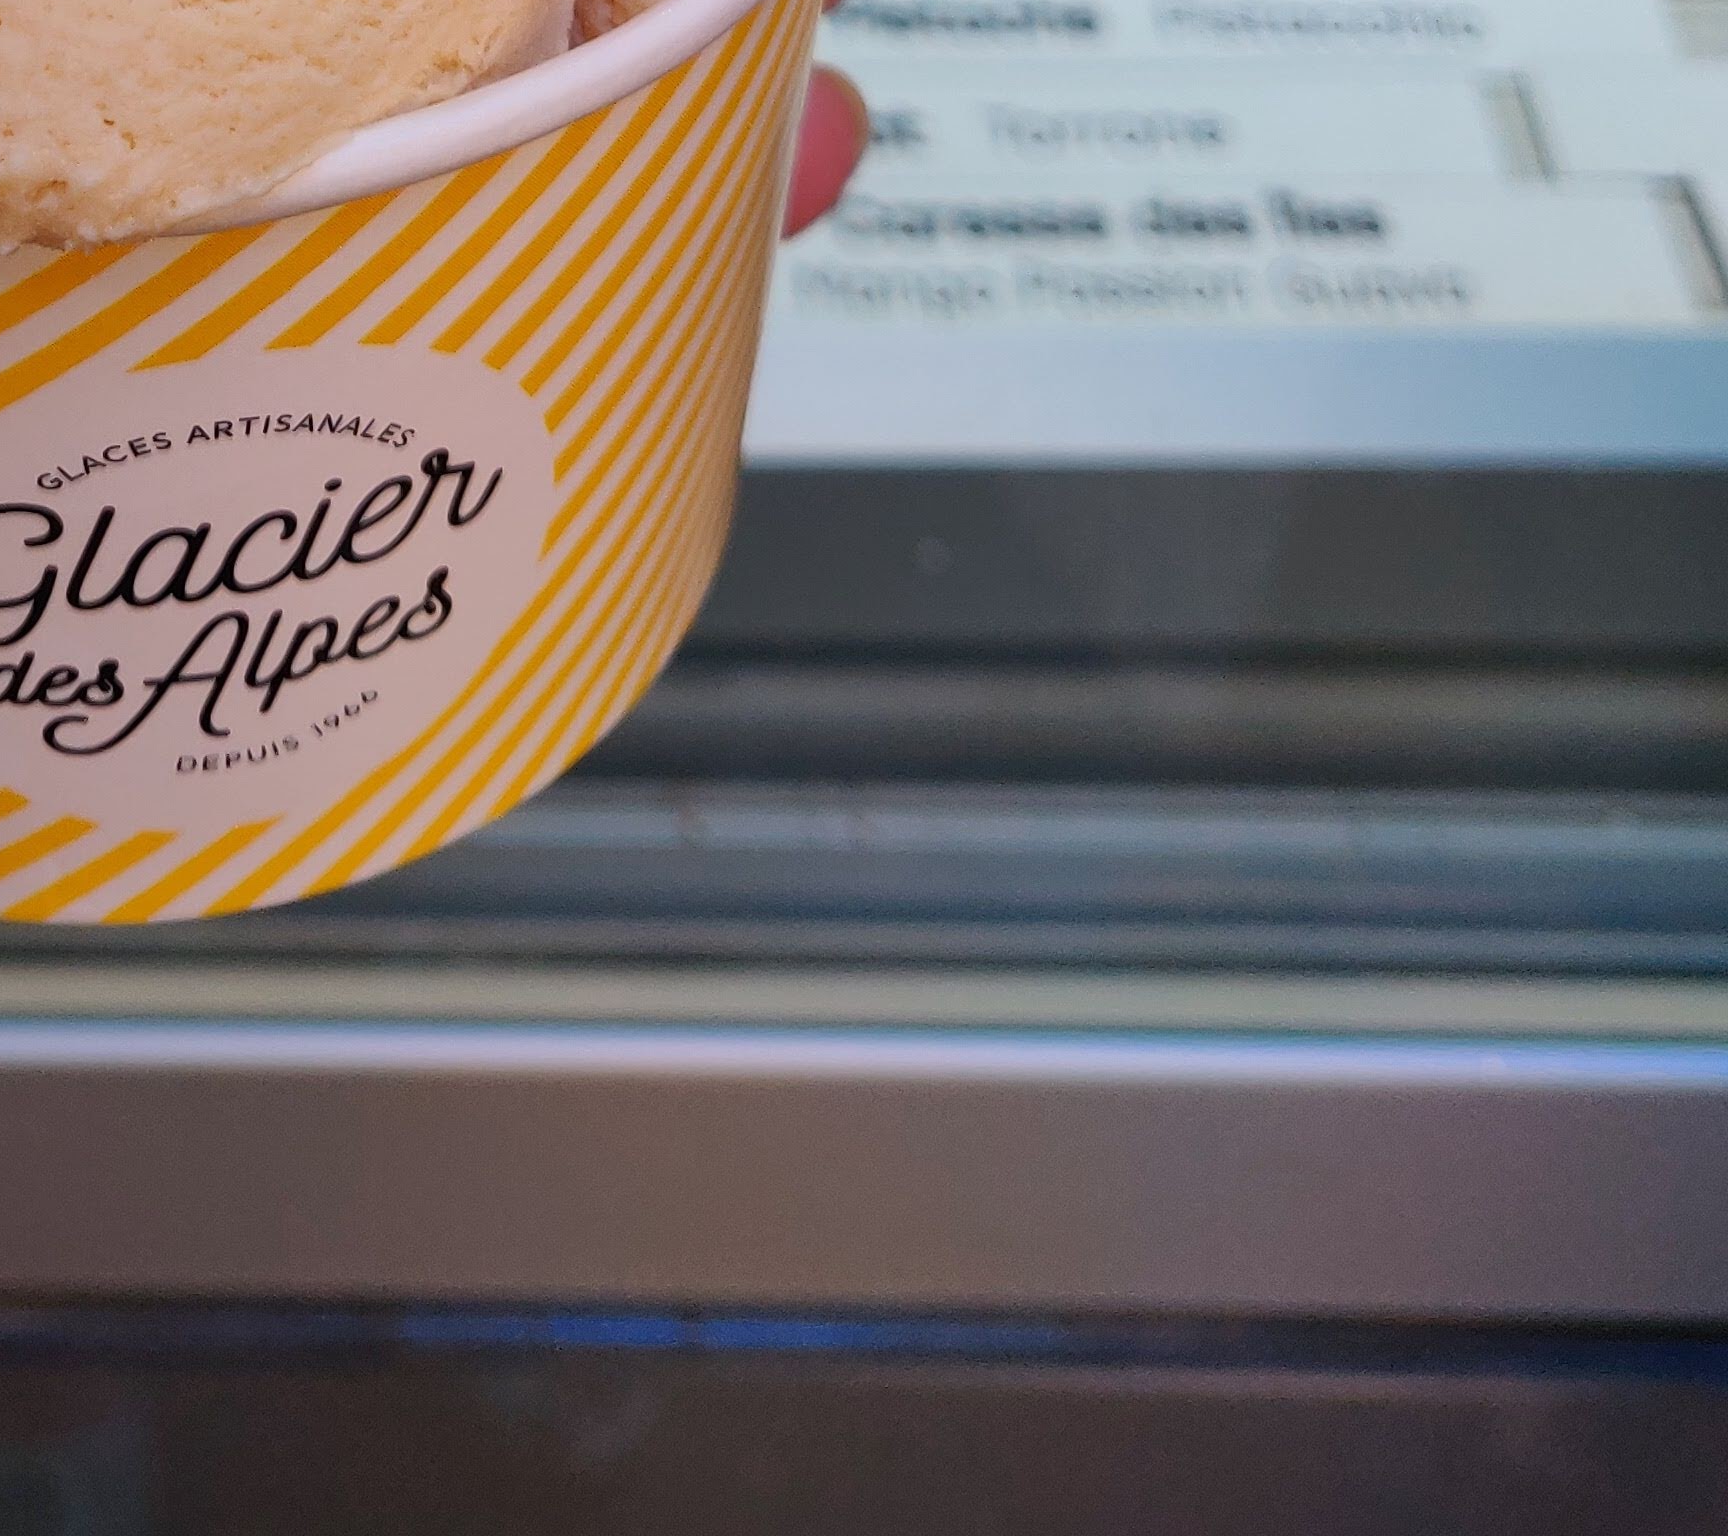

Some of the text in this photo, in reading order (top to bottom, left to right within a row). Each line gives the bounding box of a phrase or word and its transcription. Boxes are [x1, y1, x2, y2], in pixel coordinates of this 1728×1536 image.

[35, 412, 416, 491] GLACES ARTISANALES
[42, 565, 454, 756] Alpes
[175, 734, 300, 773] DEPUIS
